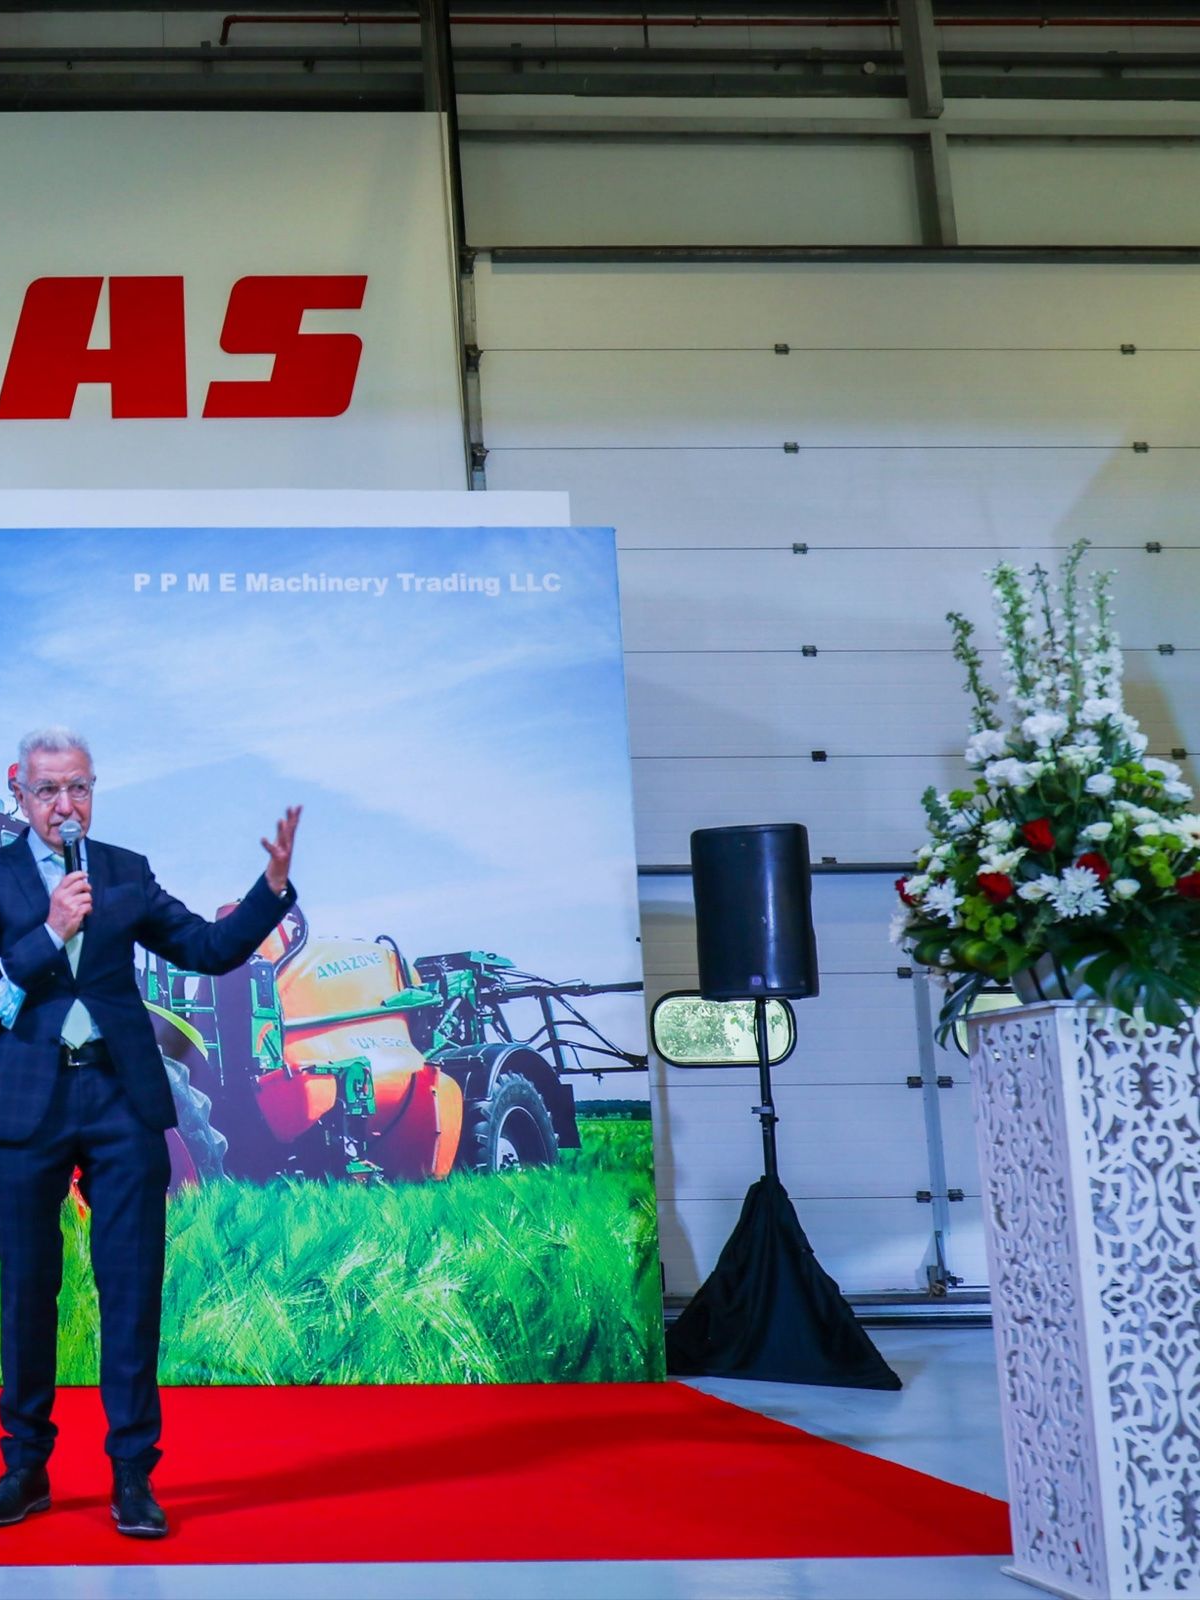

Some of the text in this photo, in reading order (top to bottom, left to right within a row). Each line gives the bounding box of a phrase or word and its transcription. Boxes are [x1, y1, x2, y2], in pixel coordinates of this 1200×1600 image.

[134, 572, 561, 596] P P M E Machinery Trading LLC
